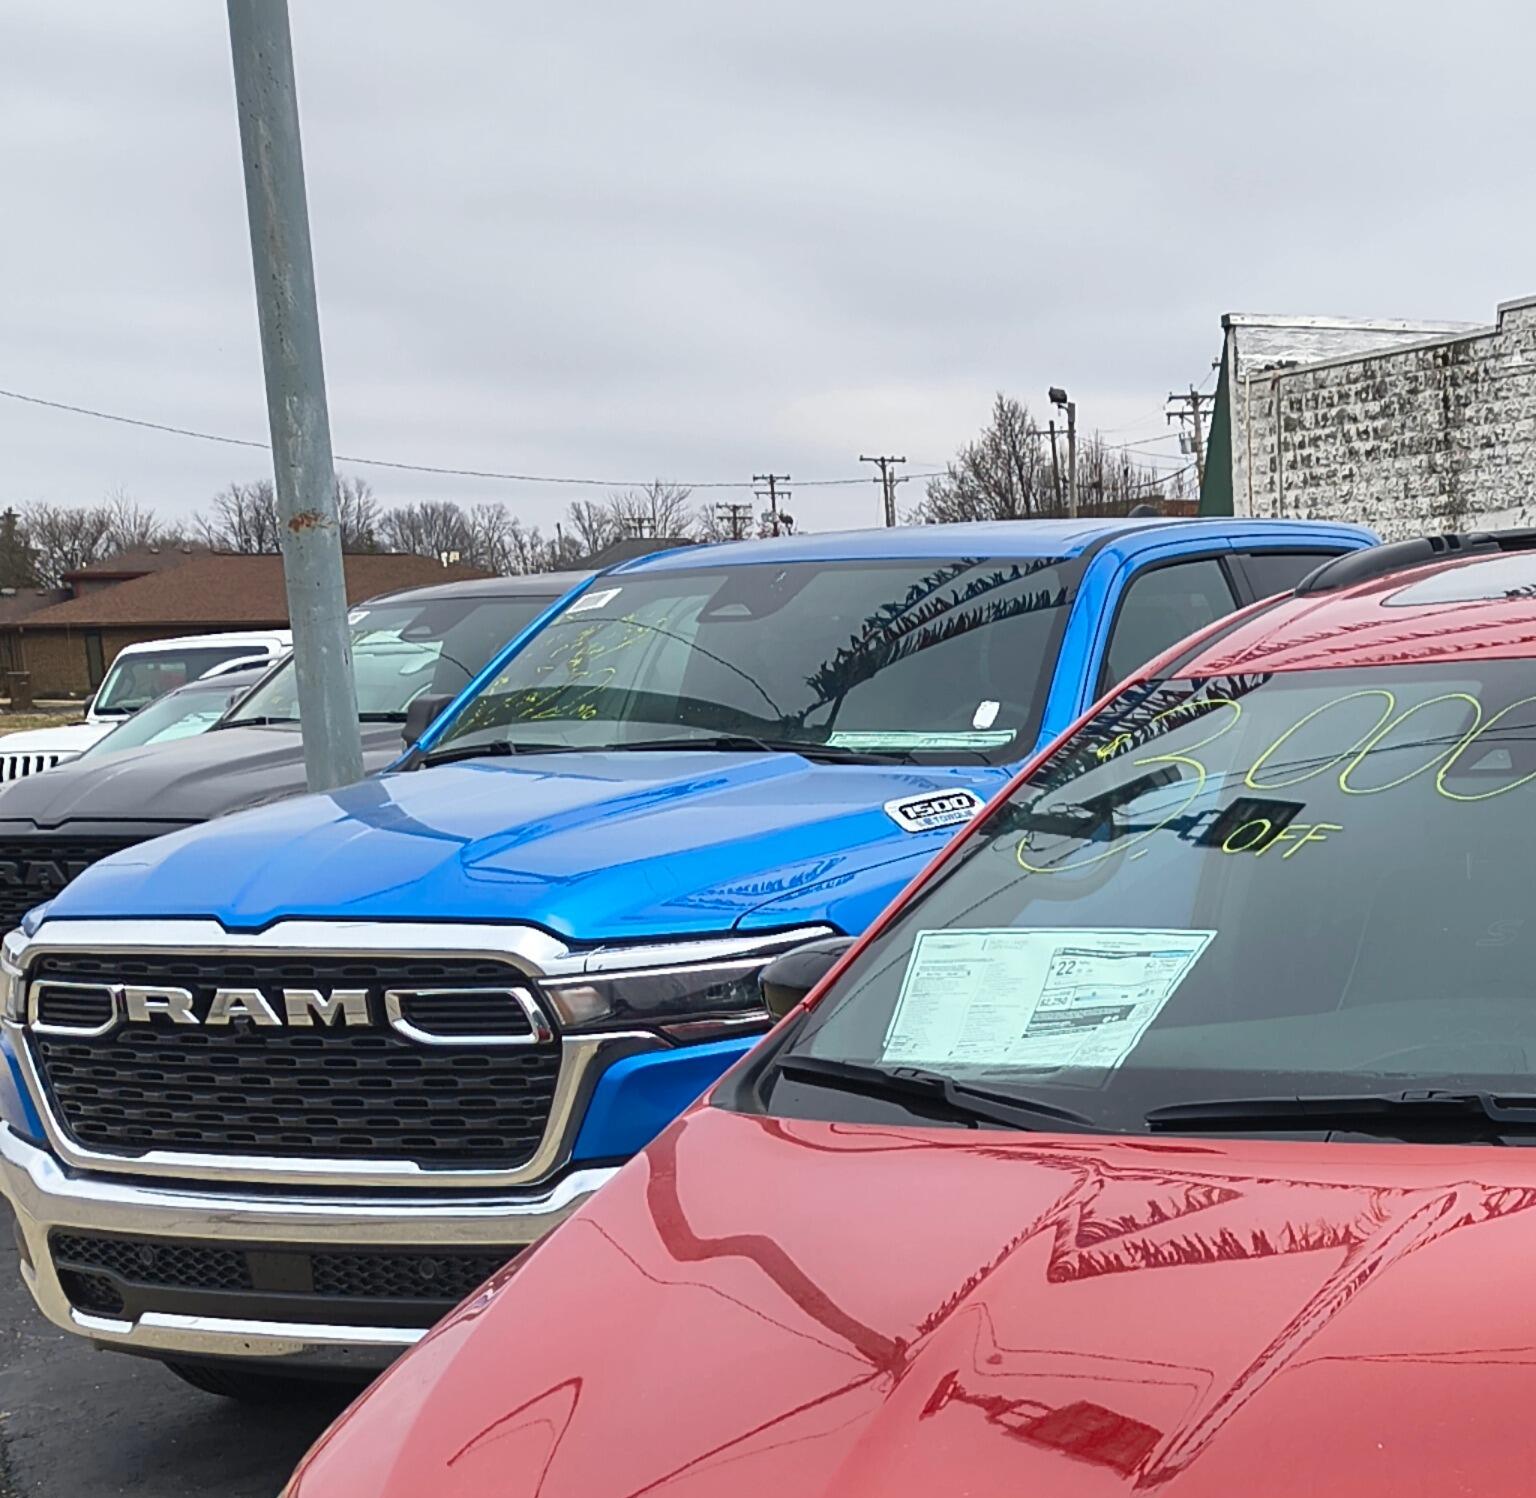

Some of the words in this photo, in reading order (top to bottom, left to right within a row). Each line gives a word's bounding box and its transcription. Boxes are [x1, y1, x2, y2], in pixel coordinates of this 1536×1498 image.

[901, 795, 971, 818] 1500
[1222, 818, 1344, 859] OFF
[1056, 960, 1076, 976] 22
[124, 984, 374, 1027] RAM
